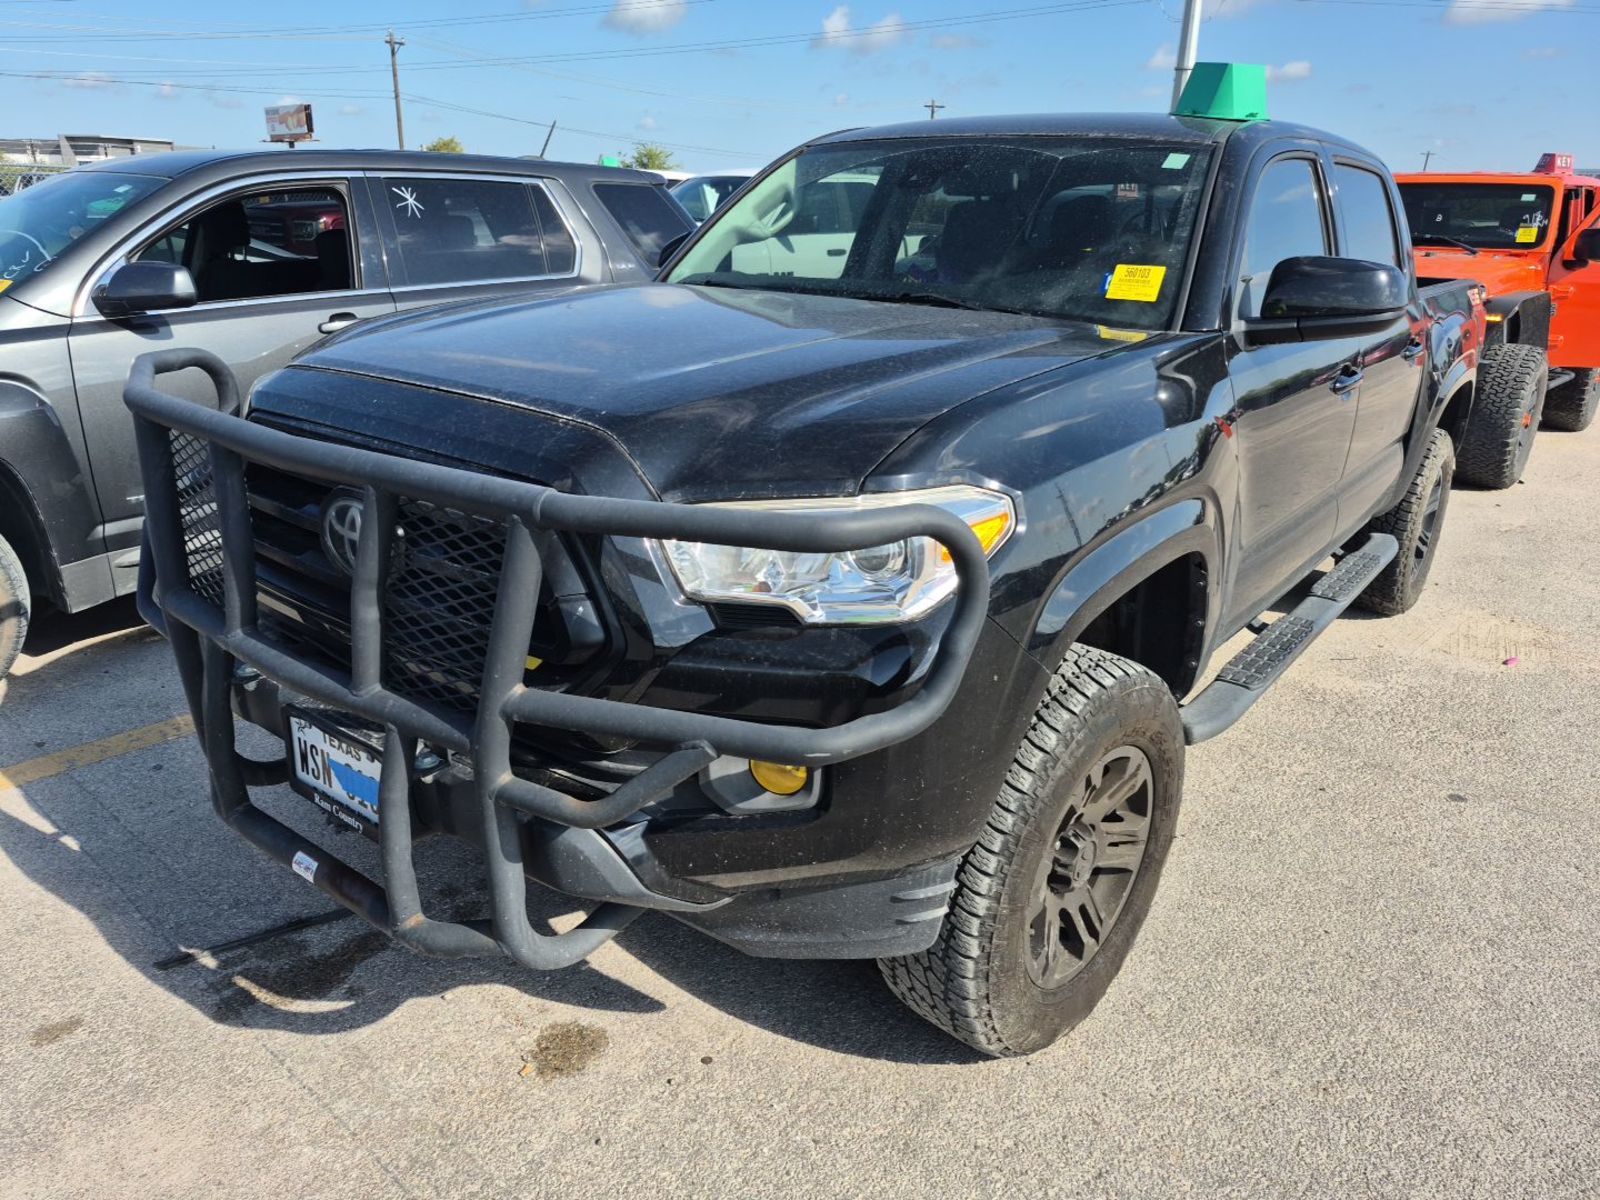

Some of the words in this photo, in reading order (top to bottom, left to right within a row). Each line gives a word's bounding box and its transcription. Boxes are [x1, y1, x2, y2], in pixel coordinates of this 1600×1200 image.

[1124, 267, 1151, 278] 560103
[322, 732, 362, 762] TEXAS
[314, 792, 332, 812] Ram
[332, 805, 363, 834] Country
